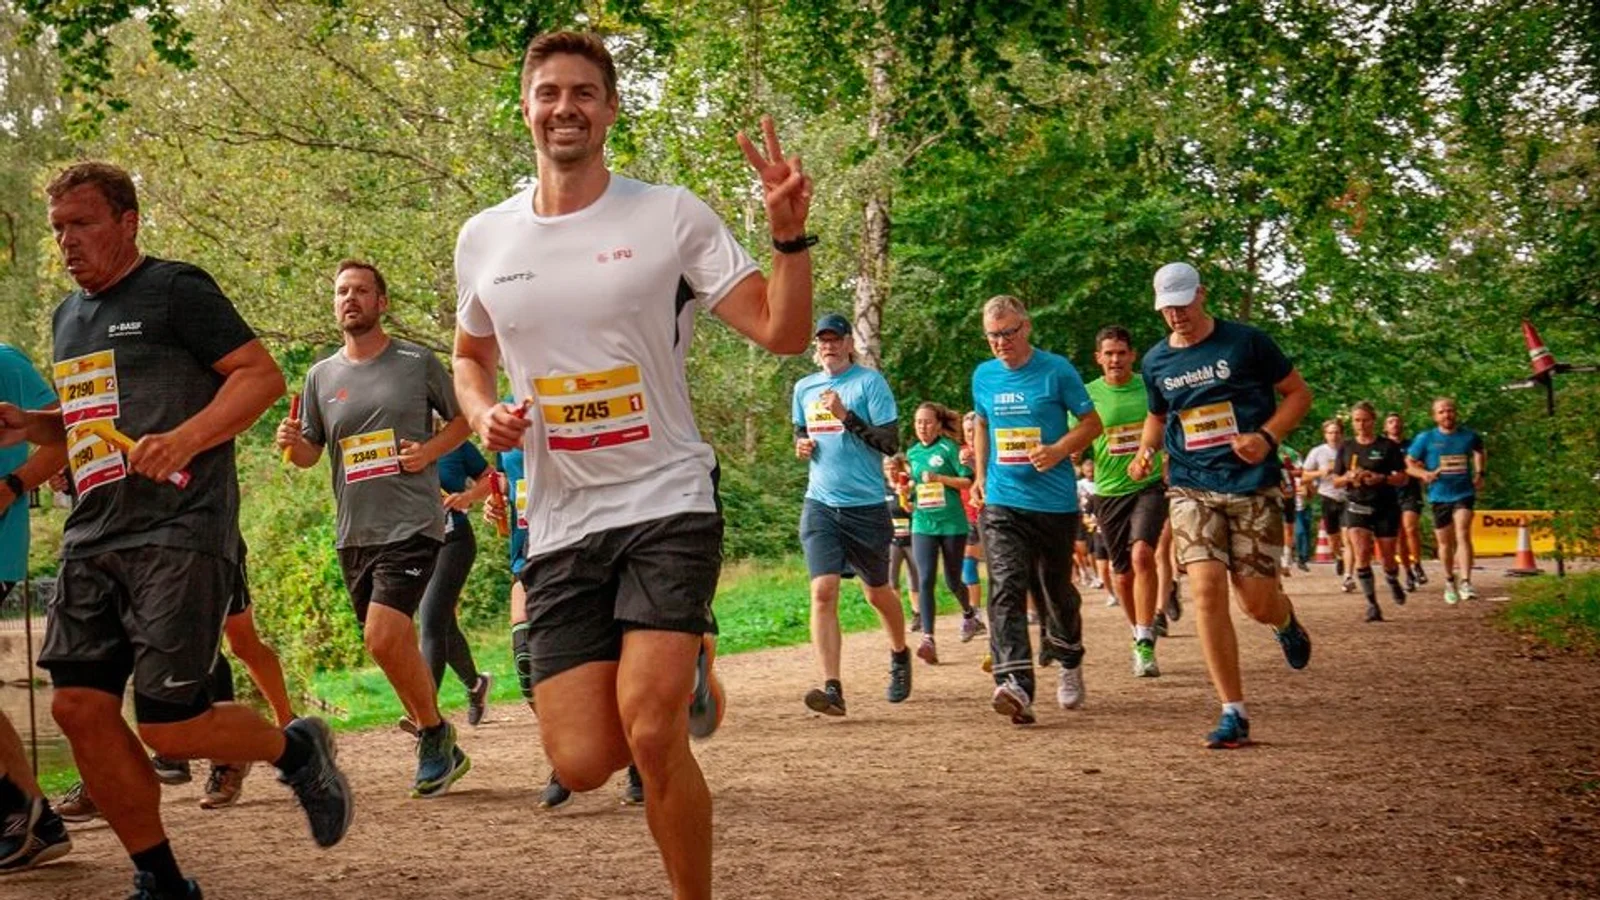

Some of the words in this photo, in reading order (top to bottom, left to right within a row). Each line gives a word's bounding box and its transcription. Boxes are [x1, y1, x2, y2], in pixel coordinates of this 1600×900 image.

[120, 321, 142, 331] BASF
[69, 381, 95, 400] 2190
[106, 379, 115, 390] 2
[563, 401, 610, 423] 2745
[631, 396, 640, 410] 1
[352, 449, 377, 463] 2349
